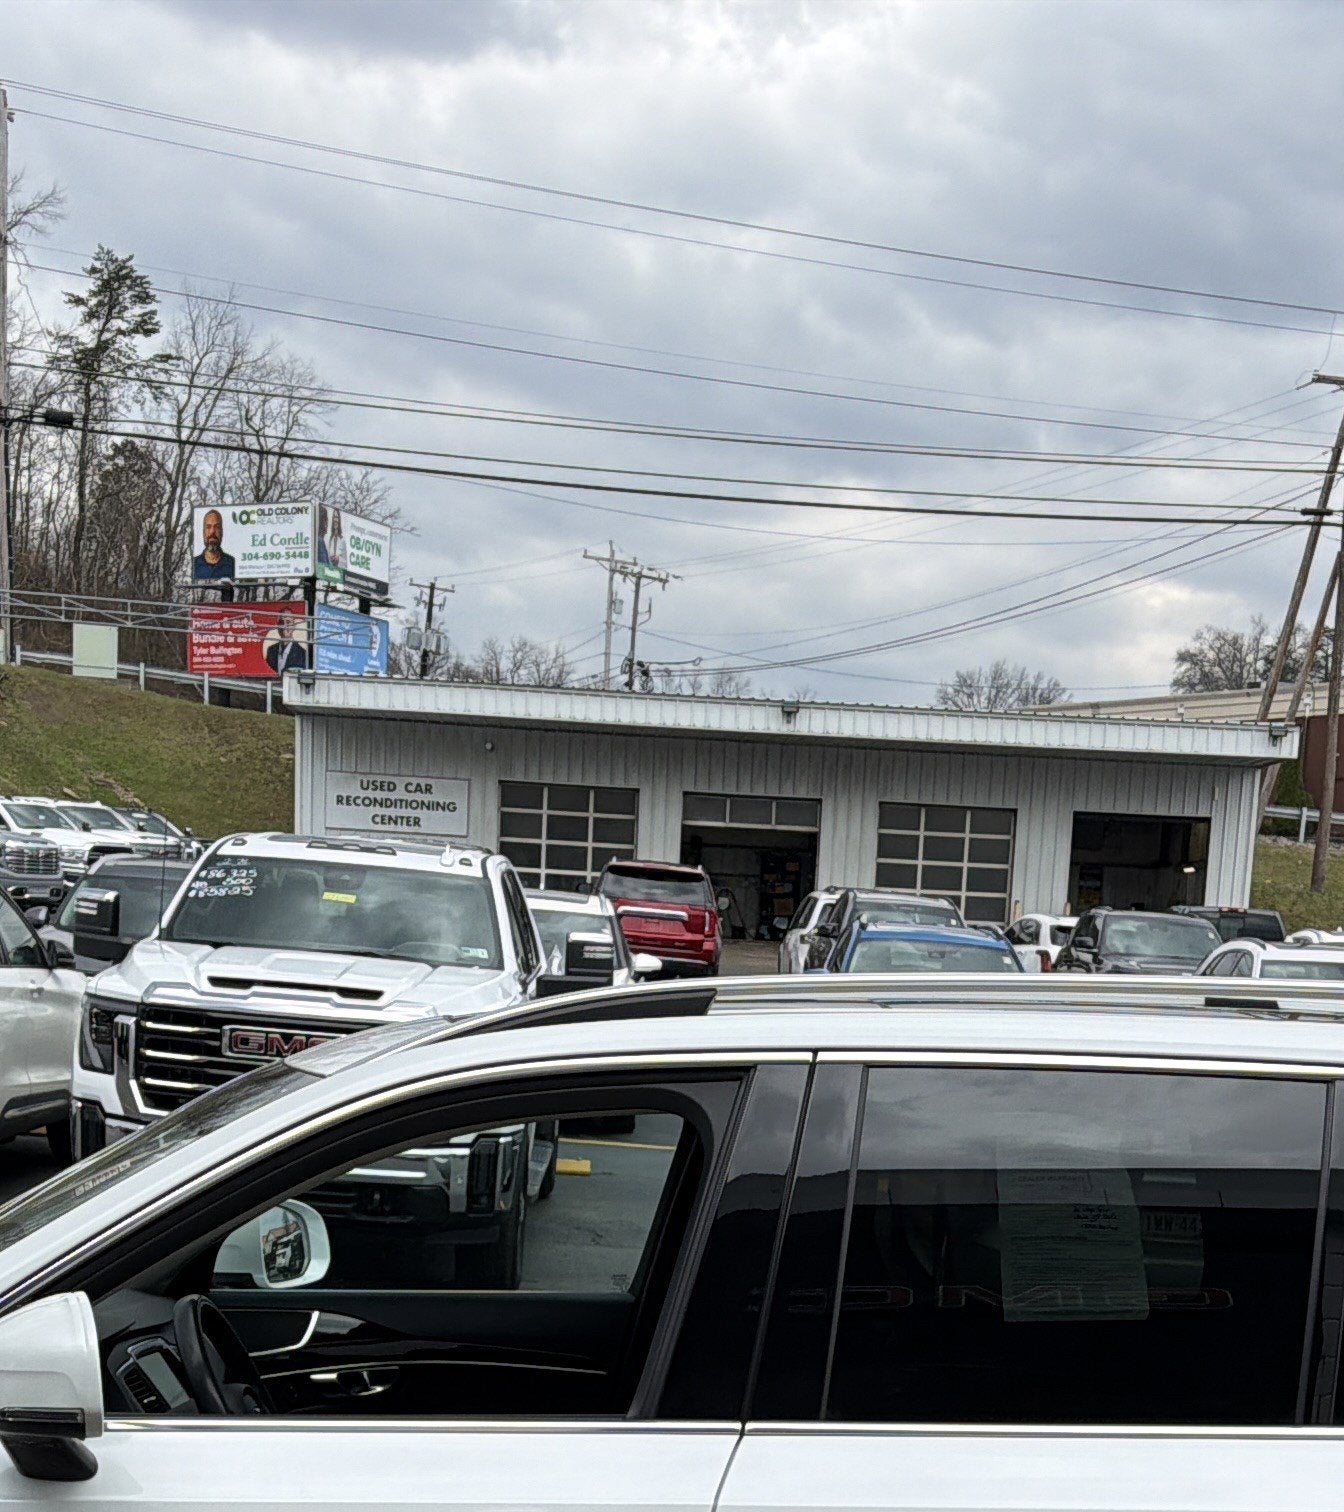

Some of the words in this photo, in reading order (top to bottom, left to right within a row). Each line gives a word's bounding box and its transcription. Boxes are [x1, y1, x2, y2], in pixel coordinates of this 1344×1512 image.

[256, 507, 274, 517] OLD
[275, 505, 309, 516] COLONY
[251, 532, 267, 547] Ed
[270, 531, 310, 547] Cordle
[349, 534, 382, 558] OB/GYN
[349, 551, 371, 571] CARE
[360, 779, 397, 792] USED
[404, 782, 433, 795] CAR
[336, 795, 457, 812] RECONDITIONING
[371, 813, 422, 828] CENTER
